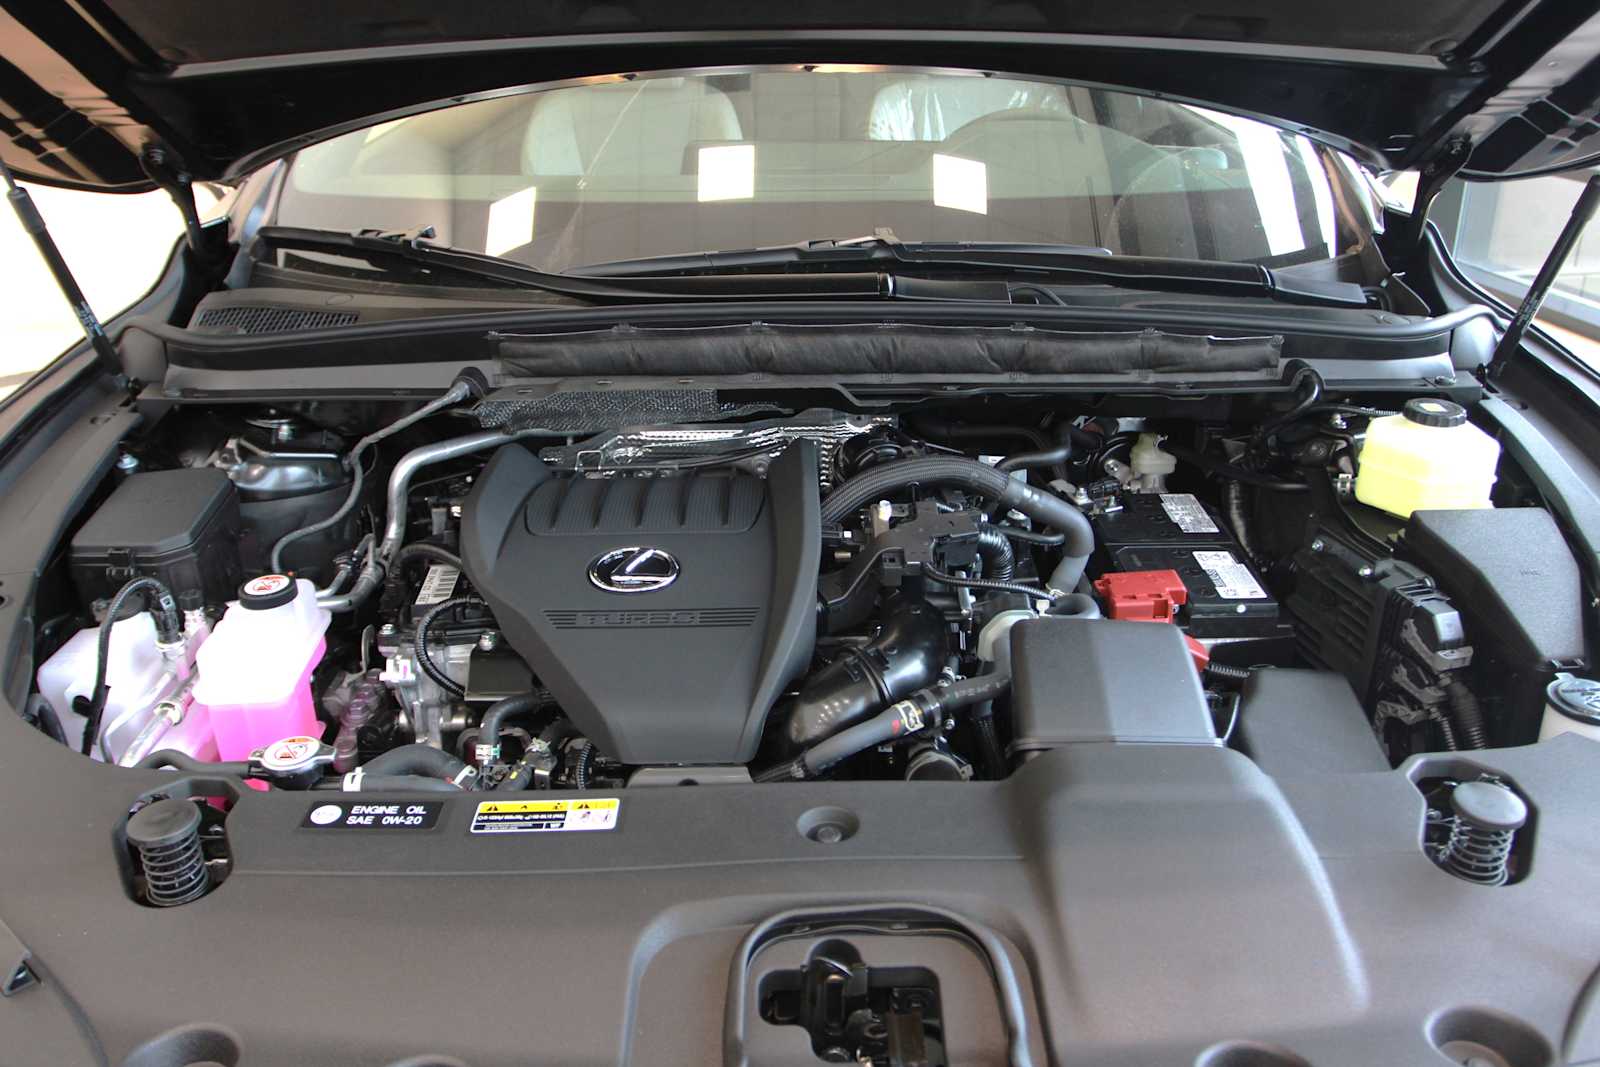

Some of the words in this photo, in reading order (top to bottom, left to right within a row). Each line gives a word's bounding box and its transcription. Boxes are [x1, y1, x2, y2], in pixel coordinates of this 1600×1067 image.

[577, 611, 699, 625] TURBO
[351, 805, 400, 815] ENGINE
[406, 805, 427, 815] OIL
[346, 815, 375, 825] SAE
[381, 815, 423, 825] 0W-20
